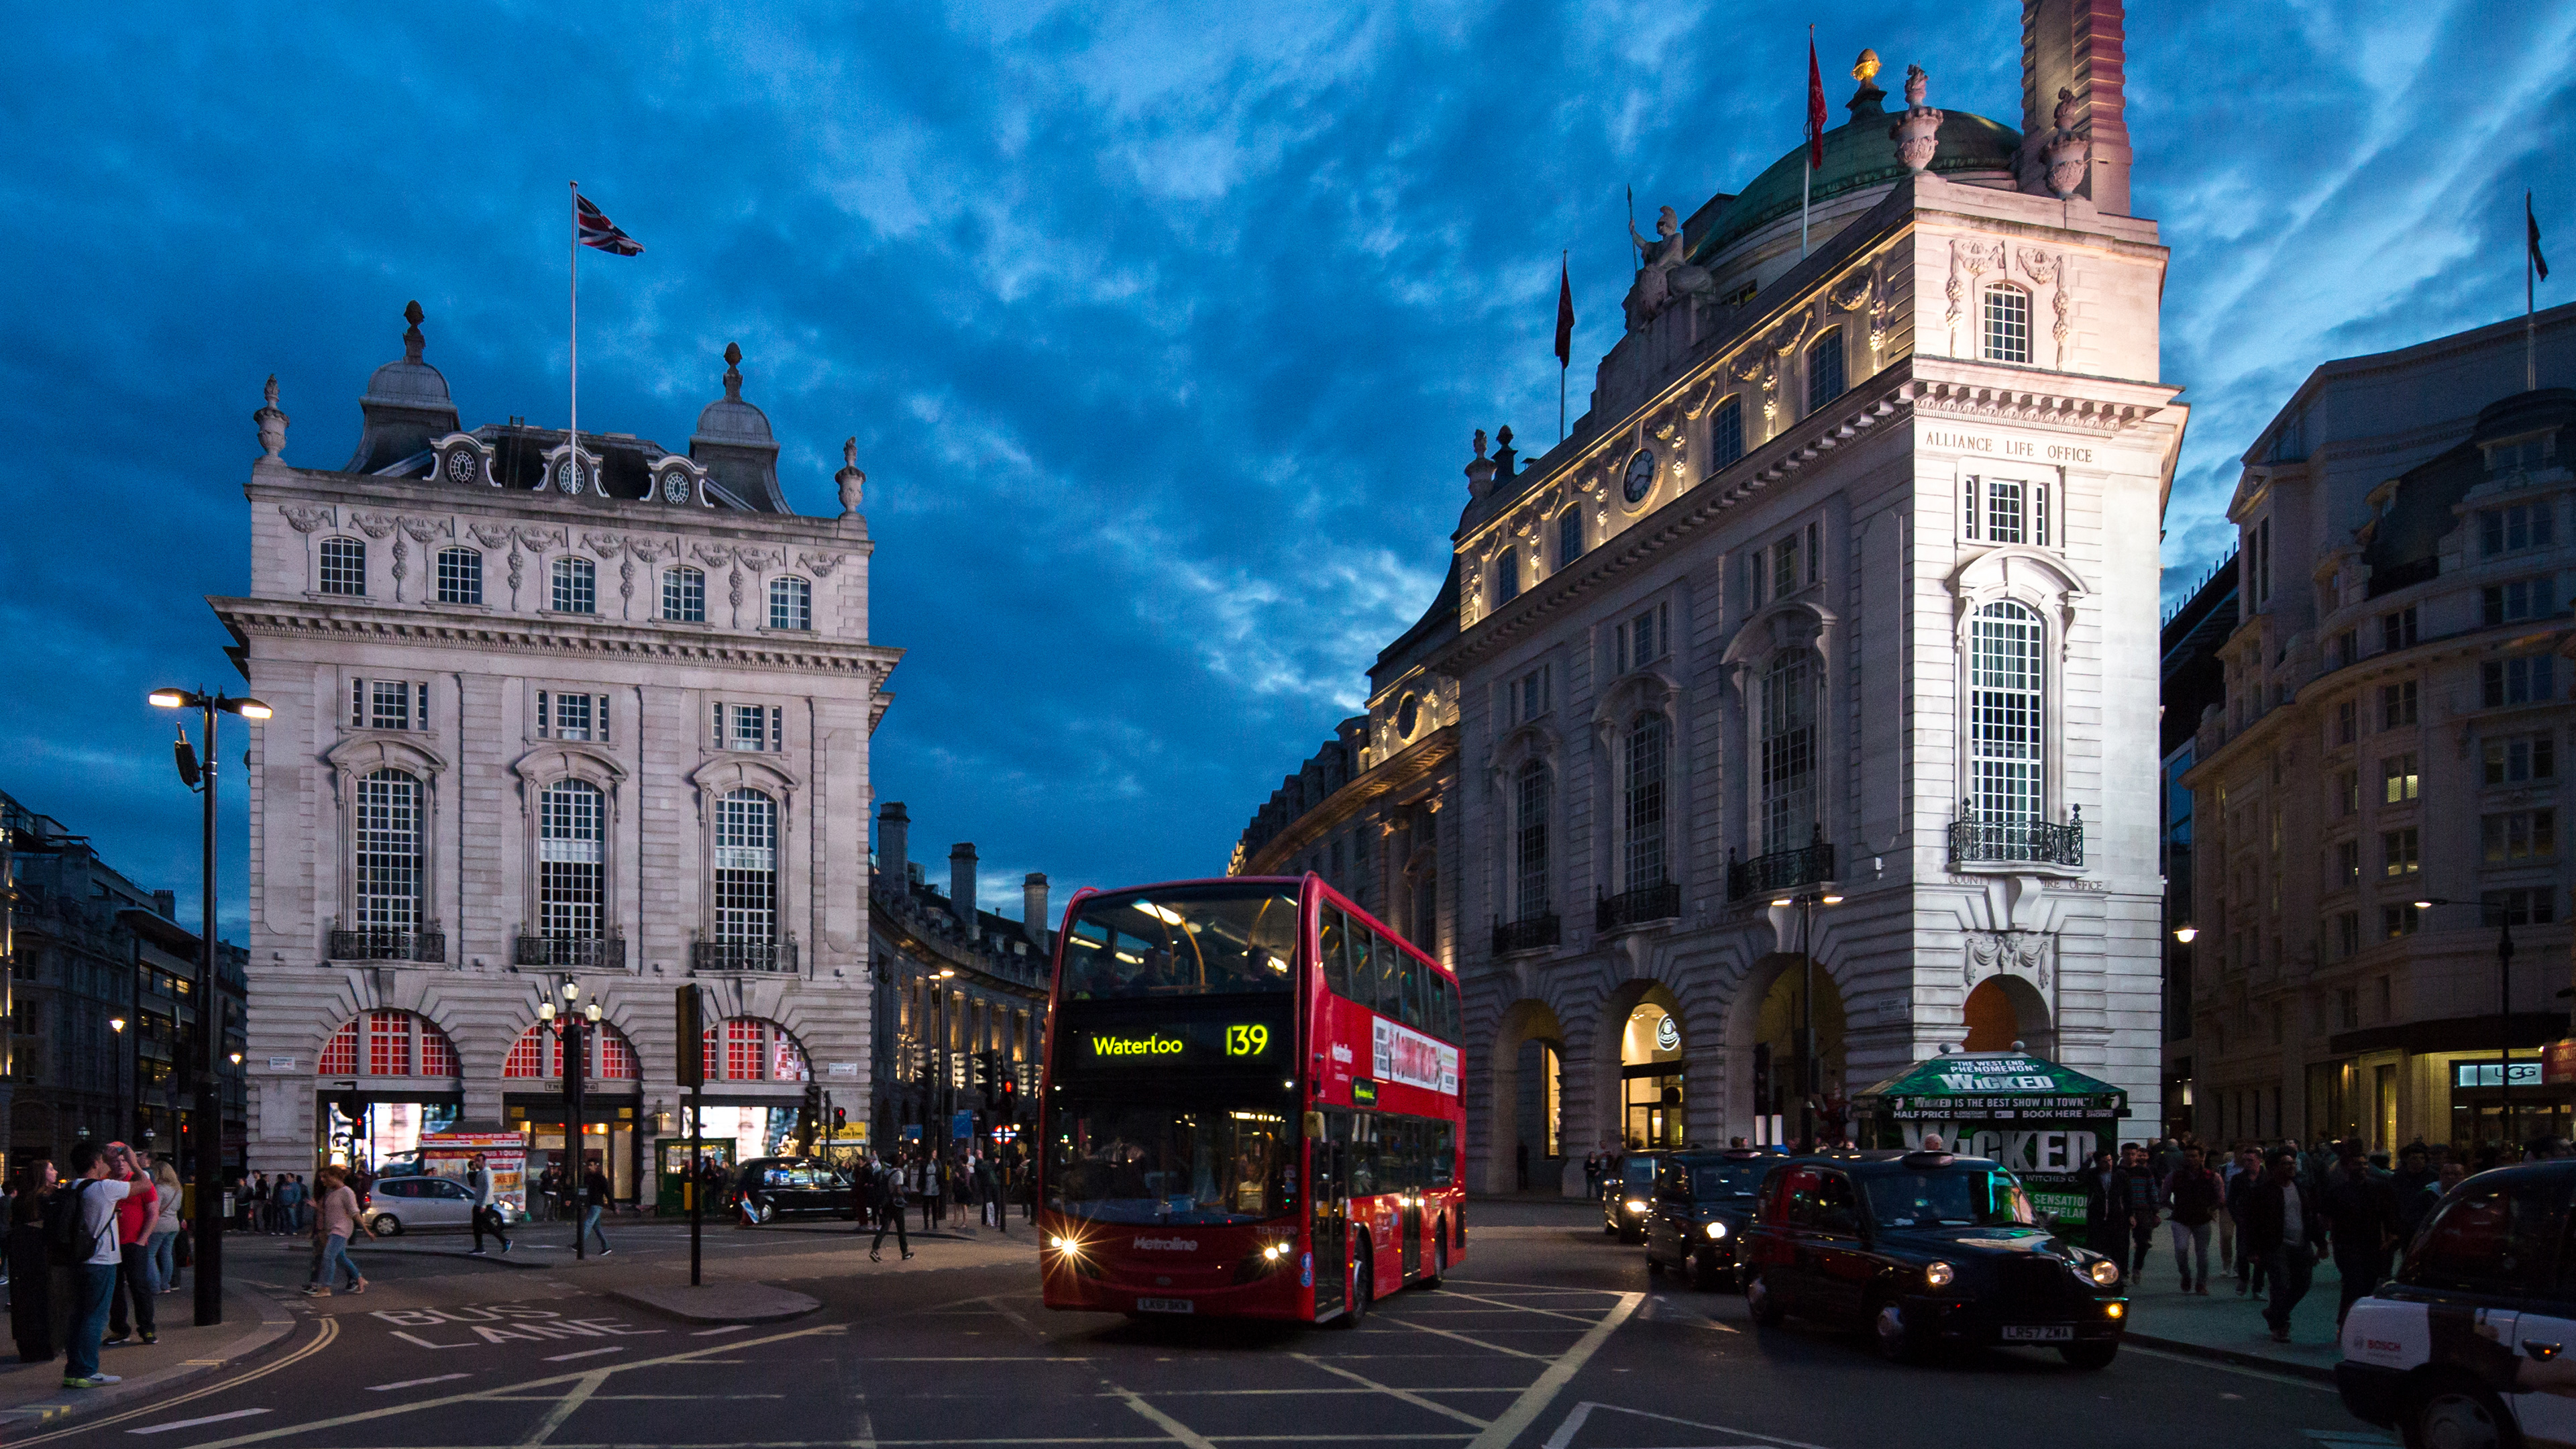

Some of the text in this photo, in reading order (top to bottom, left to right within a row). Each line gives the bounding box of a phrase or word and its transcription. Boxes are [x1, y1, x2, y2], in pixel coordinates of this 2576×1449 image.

[1926, 431, 2092, 463] ALLIANCE LIFE OFFICE
[1093, 1024, 1268, 1056] Waterloo 139
[1955, 1098, 1964, 1108] IS
[1967, 1098, 1984, 1107] THE
[1987, 1098, 2010, 1107] BEST
[2012, 1098, 2041, 1107] SHOW
[2043, 1098, 2053, 1107] IN
[1893, 1110, 1950, 1118] HALF PRICE
[2023, 1110, 2053, 1118] BOOK
[2025, 1174, 2066, 1183] WITCHES
[2068, 1175, 2078, 1183] O
[1134, 1236, 1199, 1251] Metroline
[369, 1305, 561, 1327] BUS
[390, 1318, 667, 1349] LANE
[2367, 1339, 2401, 1352] BOSCH
